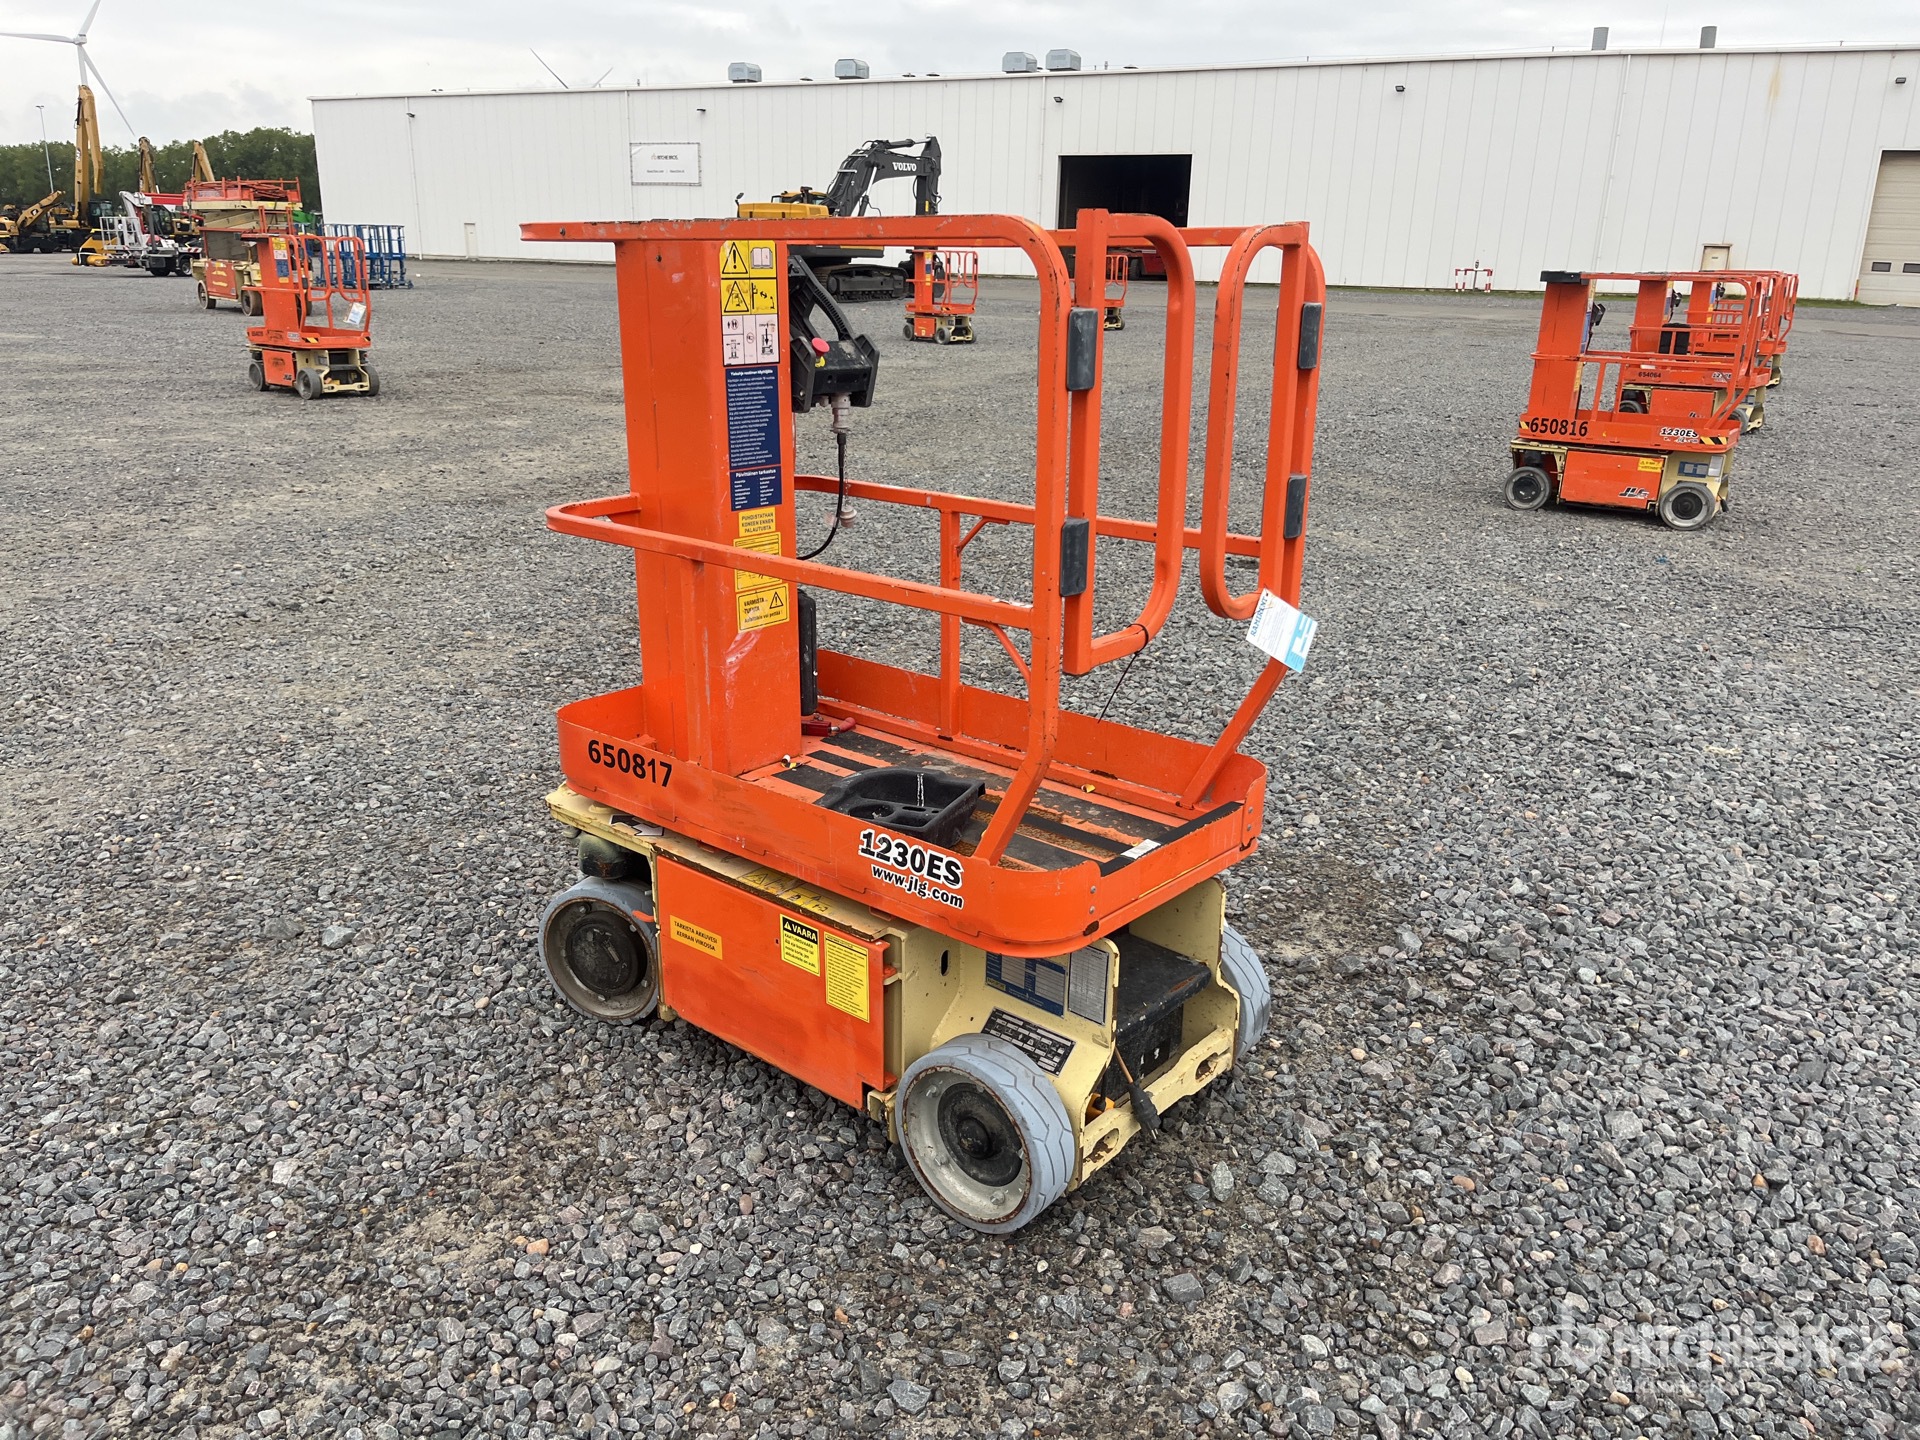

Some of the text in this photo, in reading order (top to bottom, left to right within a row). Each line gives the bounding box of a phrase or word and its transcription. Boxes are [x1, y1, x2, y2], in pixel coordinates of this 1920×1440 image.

[892, 162, 917, 172] VOLVO
[1530, 417, 1589, 437] 650816
[1660, 428, 1698, 438] 1230ES
[588, 739, 673, 788] 650817
[859, 830, 963, 887] 1230ES
[871, 865, 964, 909] www.jlg.com
[673, 920, 695, 934] TARKISTA
[791, 923, 817, 942] VAARA
[676, 930, 716, 951] KERRAN VIIKOSSA
